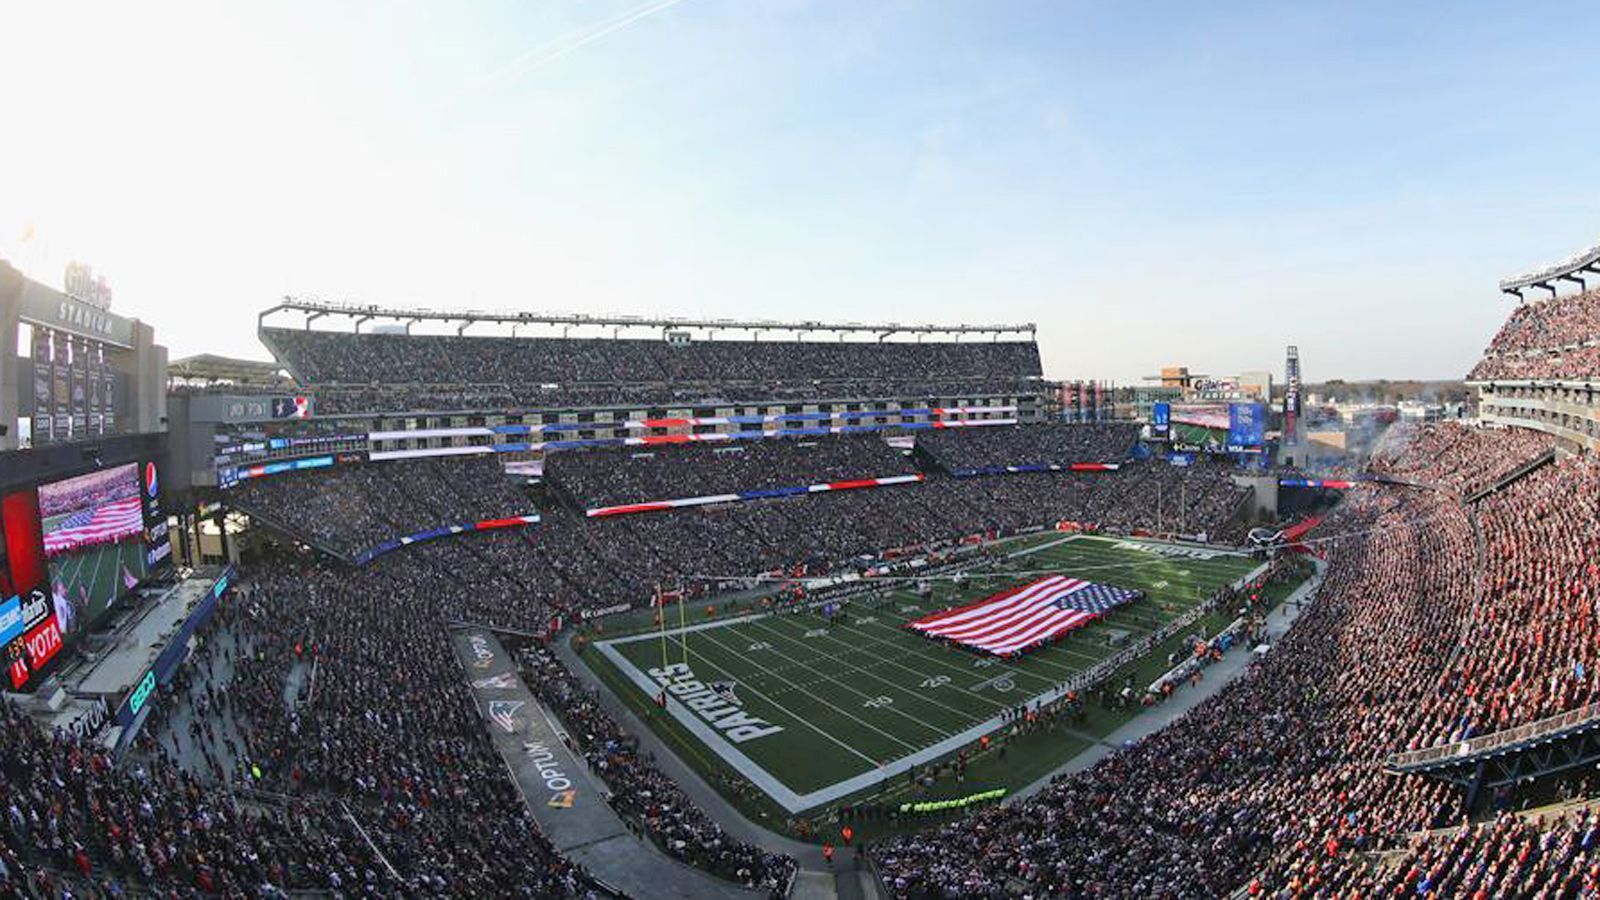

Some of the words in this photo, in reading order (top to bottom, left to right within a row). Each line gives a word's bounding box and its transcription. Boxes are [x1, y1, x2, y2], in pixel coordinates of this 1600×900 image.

[58, 301, 112, 334] STADIUM
[130, 671, 156, 715] GEICO
[648, 662, 786, 743] PATRIOTS
[70, 695, 109, 747] PTUM
[522, 740, 572, 790] OPTUM
